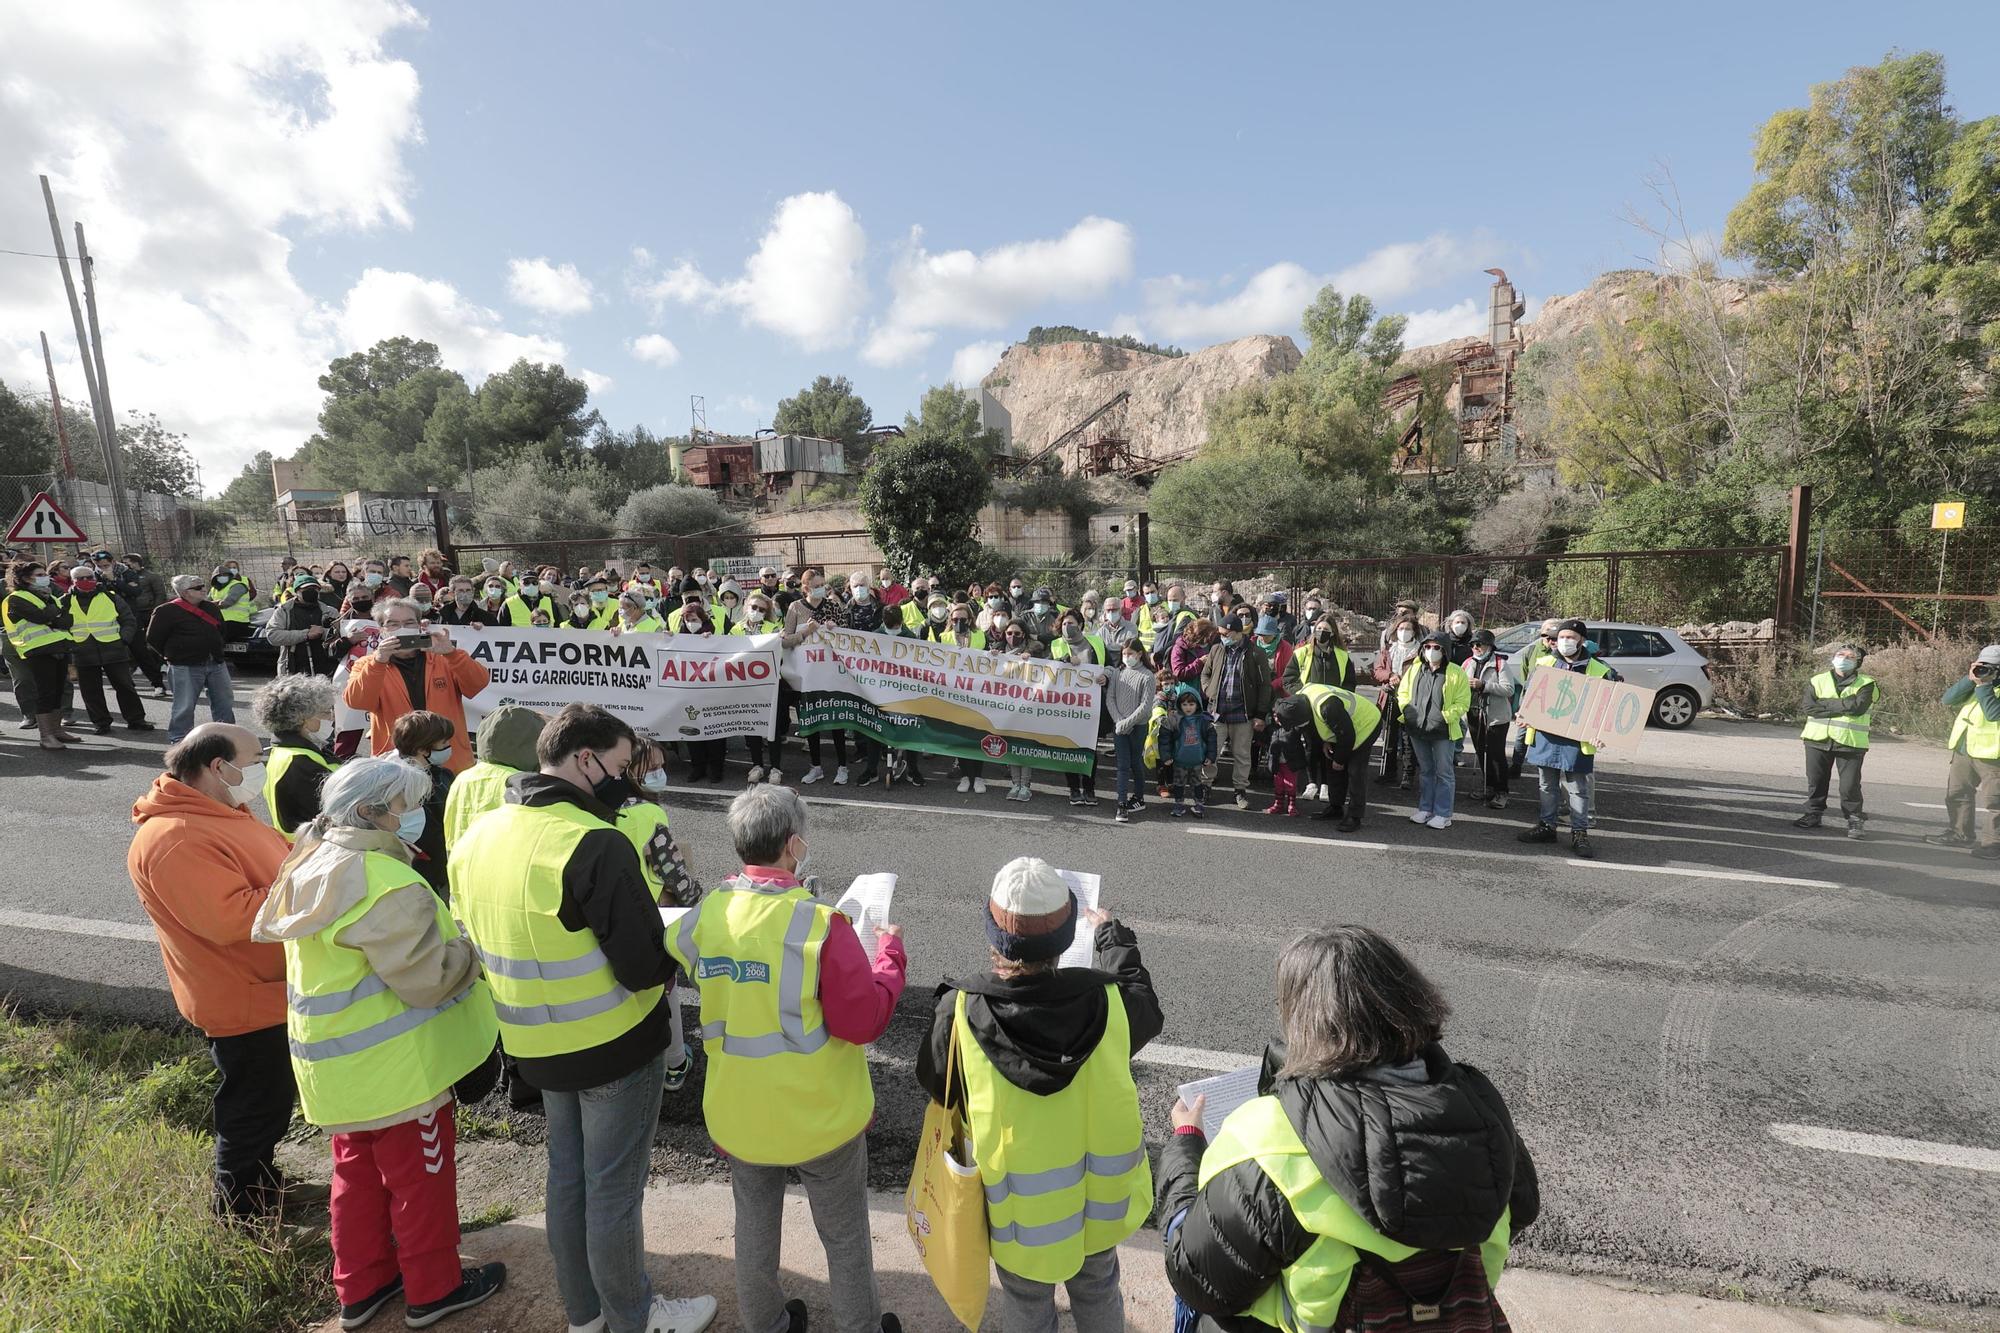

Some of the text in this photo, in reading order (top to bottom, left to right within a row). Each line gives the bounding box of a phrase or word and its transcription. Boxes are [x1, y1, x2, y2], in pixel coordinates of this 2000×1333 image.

[488, 667, 508, 683] EU
[511, 668, 529, 684] SA
[532, 669, 608, 688] GARRIGUETA
[661, 656, 770, 682] AIXÍ NO
[805, 649, 825, 663] NI
[954, 675, 975, 691] NI
[980, 680, 1092, 708] ABOCADOR
[805, 702, 814, 712] la
[815, 697, 860, 710] defensa
[861, 703, 876, 716] del
[879, 679, 928, 693] projecte
[932, 686, 945, 699] de
[948, 691, 1015, 713] restauració
[1019, 705, 1033, 715] és
[1036, 708, 1091, 721] possible
[831, 711, 836, 720] i
[838, 710, 855, 720] els
[856, 713, 883, 733] barris
[704, 729, 723, 737] NOVA
[1011, 745, 1088, 765] PLATAFORMA CIUTADANA
[745, 969, 767, 978] 2000
